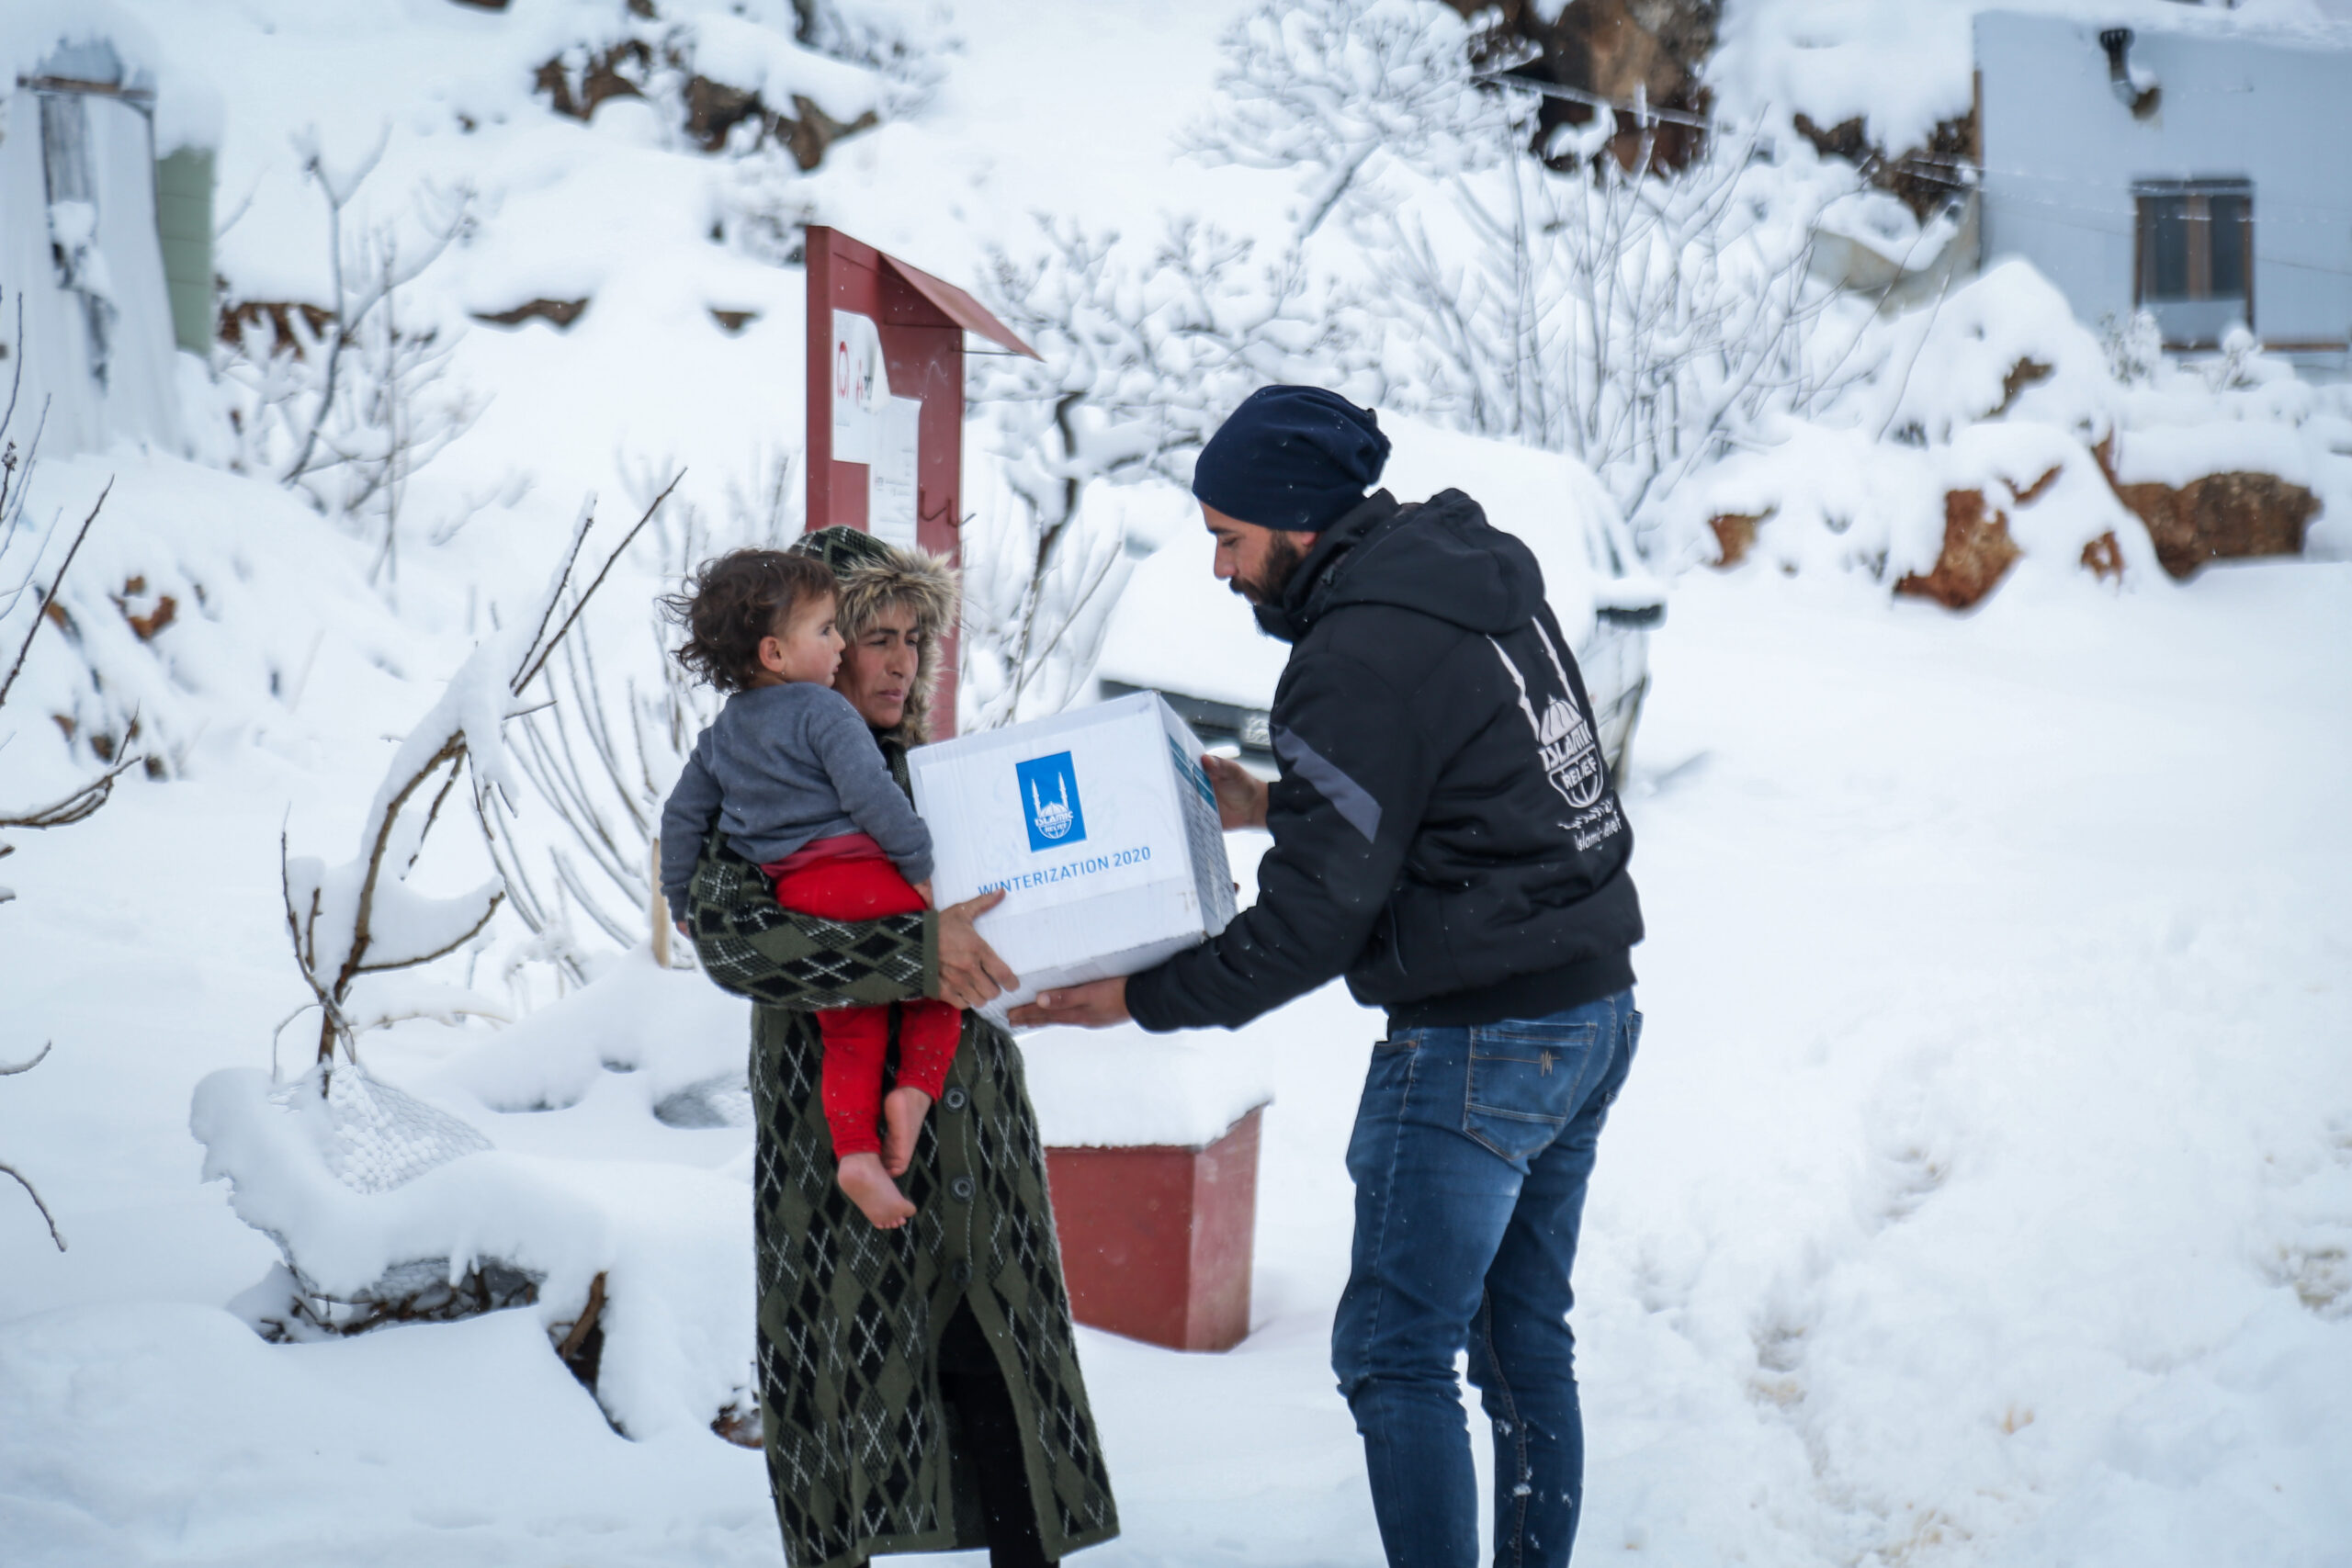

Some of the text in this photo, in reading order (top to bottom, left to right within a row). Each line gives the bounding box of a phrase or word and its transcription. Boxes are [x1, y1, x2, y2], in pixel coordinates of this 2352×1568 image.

[1562, 755, 1598, 790] RELIEF
[1035, 810, 1074, 828] ISLAMIC
[978, 846, 1151, 895] WINTERIZATION 2020
